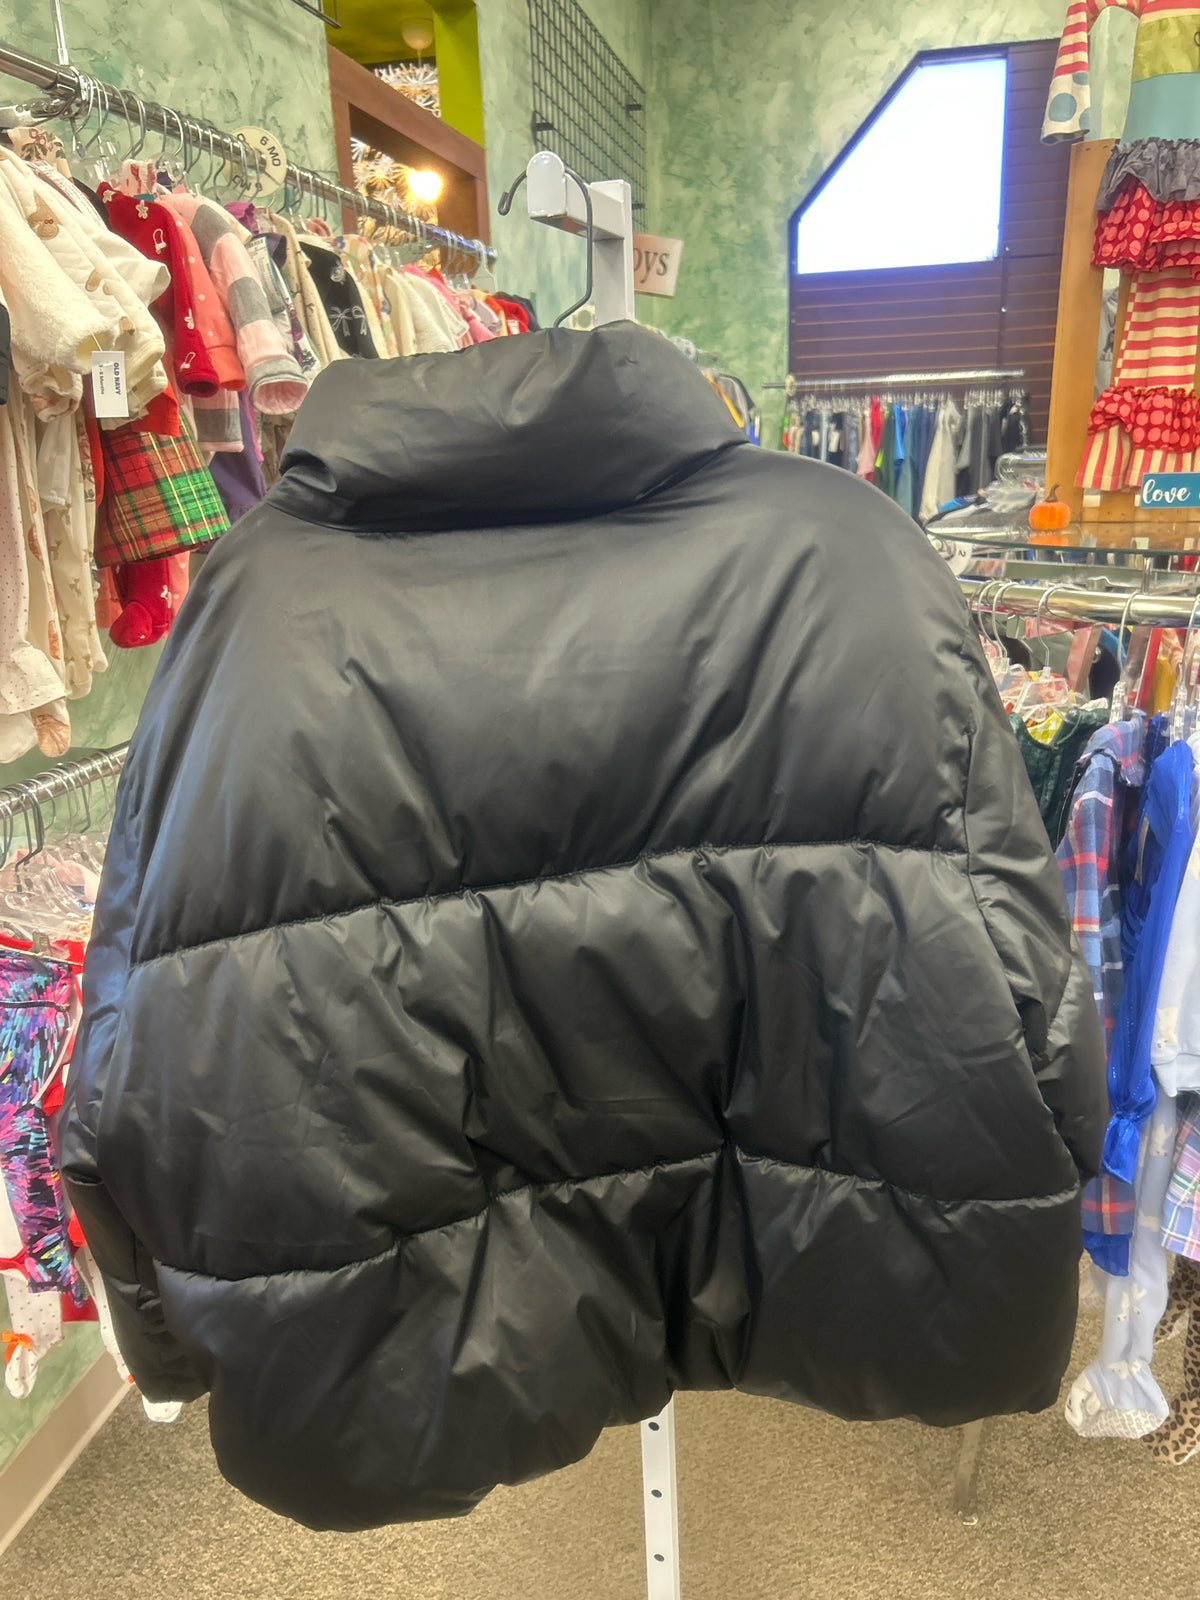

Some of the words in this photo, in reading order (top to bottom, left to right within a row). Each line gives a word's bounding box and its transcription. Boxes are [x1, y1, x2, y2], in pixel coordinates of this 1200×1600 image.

[260, 136, 269, 146] 6
[267, 146, 281, 167] MO
[114, 377, 122, 395] NAVY
[1142, 478, 1191, 504] love
